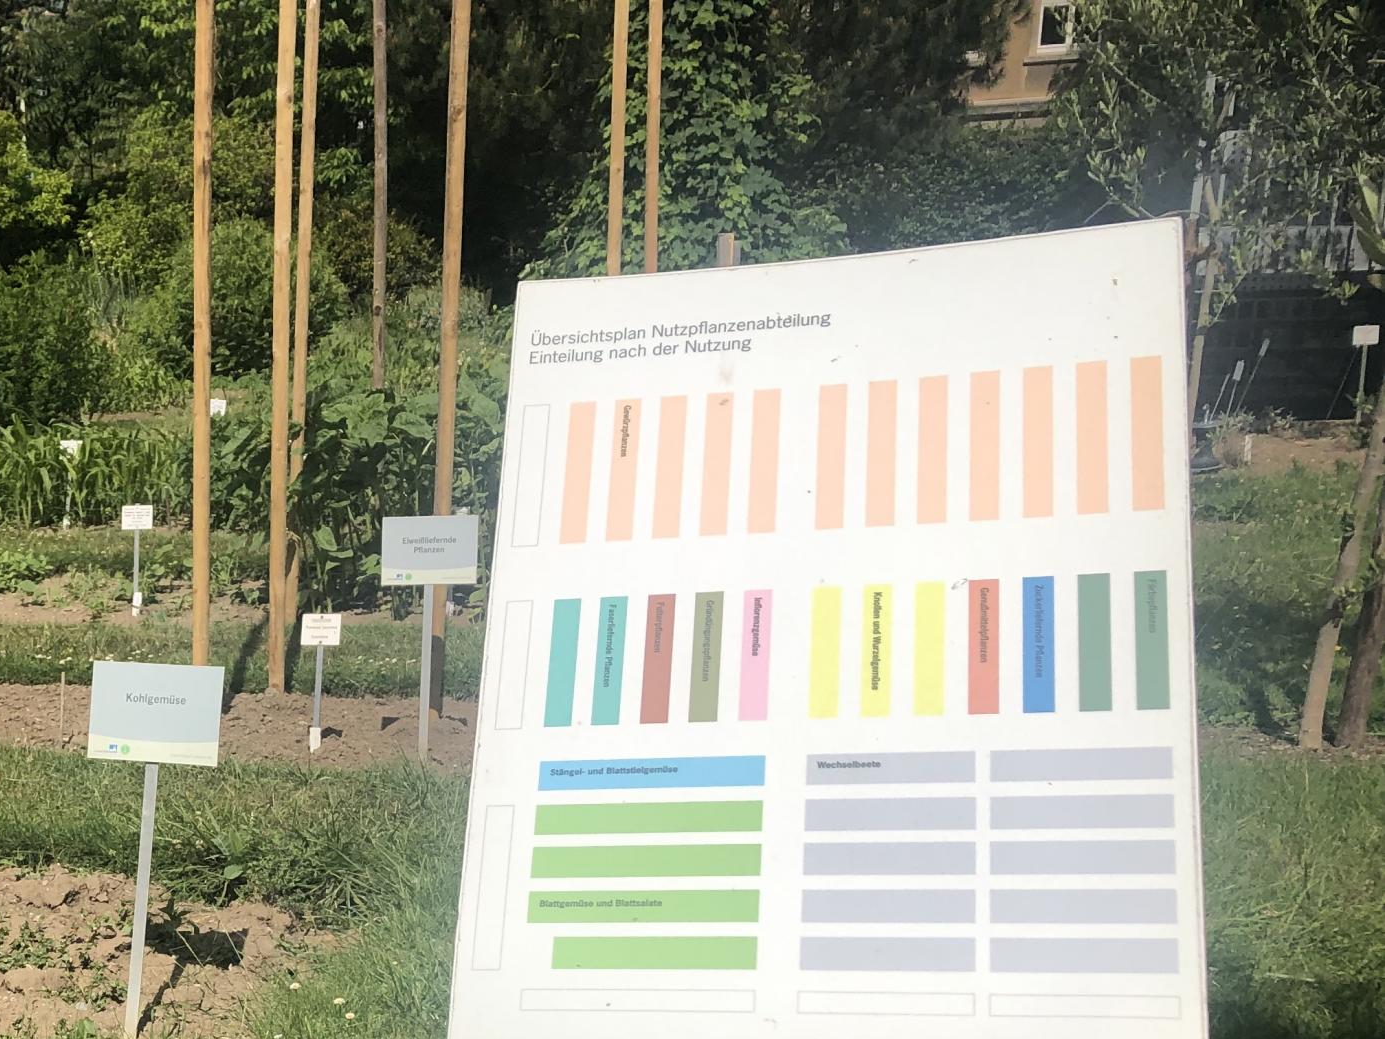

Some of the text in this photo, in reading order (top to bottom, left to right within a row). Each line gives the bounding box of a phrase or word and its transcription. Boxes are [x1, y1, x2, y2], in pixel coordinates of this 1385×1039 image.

[530, 312, 831, 347] Übersichtsplan Nutzpflanzenabteilung
[529, 337, 752, 365] Einteilung nach der Nutzung
[620, 404, 632, 458] Gewürzpflanzen
[654, 601, 665, 654] Futterpflanzen
[870, 591, 883, 691] Knollen und Wurzelgemüse
[603, 603, 617, 688] Faserliefernde Pflanzen
[125, 692, 187, 706] Kohlgemüse
[550, 765, 678, 777] Stängel- und Blattstielgemüse
[817, 760, 881, 769] Wechselbeete
[539, 899, 594, 909] Blattgemüse
[596, 899, 613, 908] und
